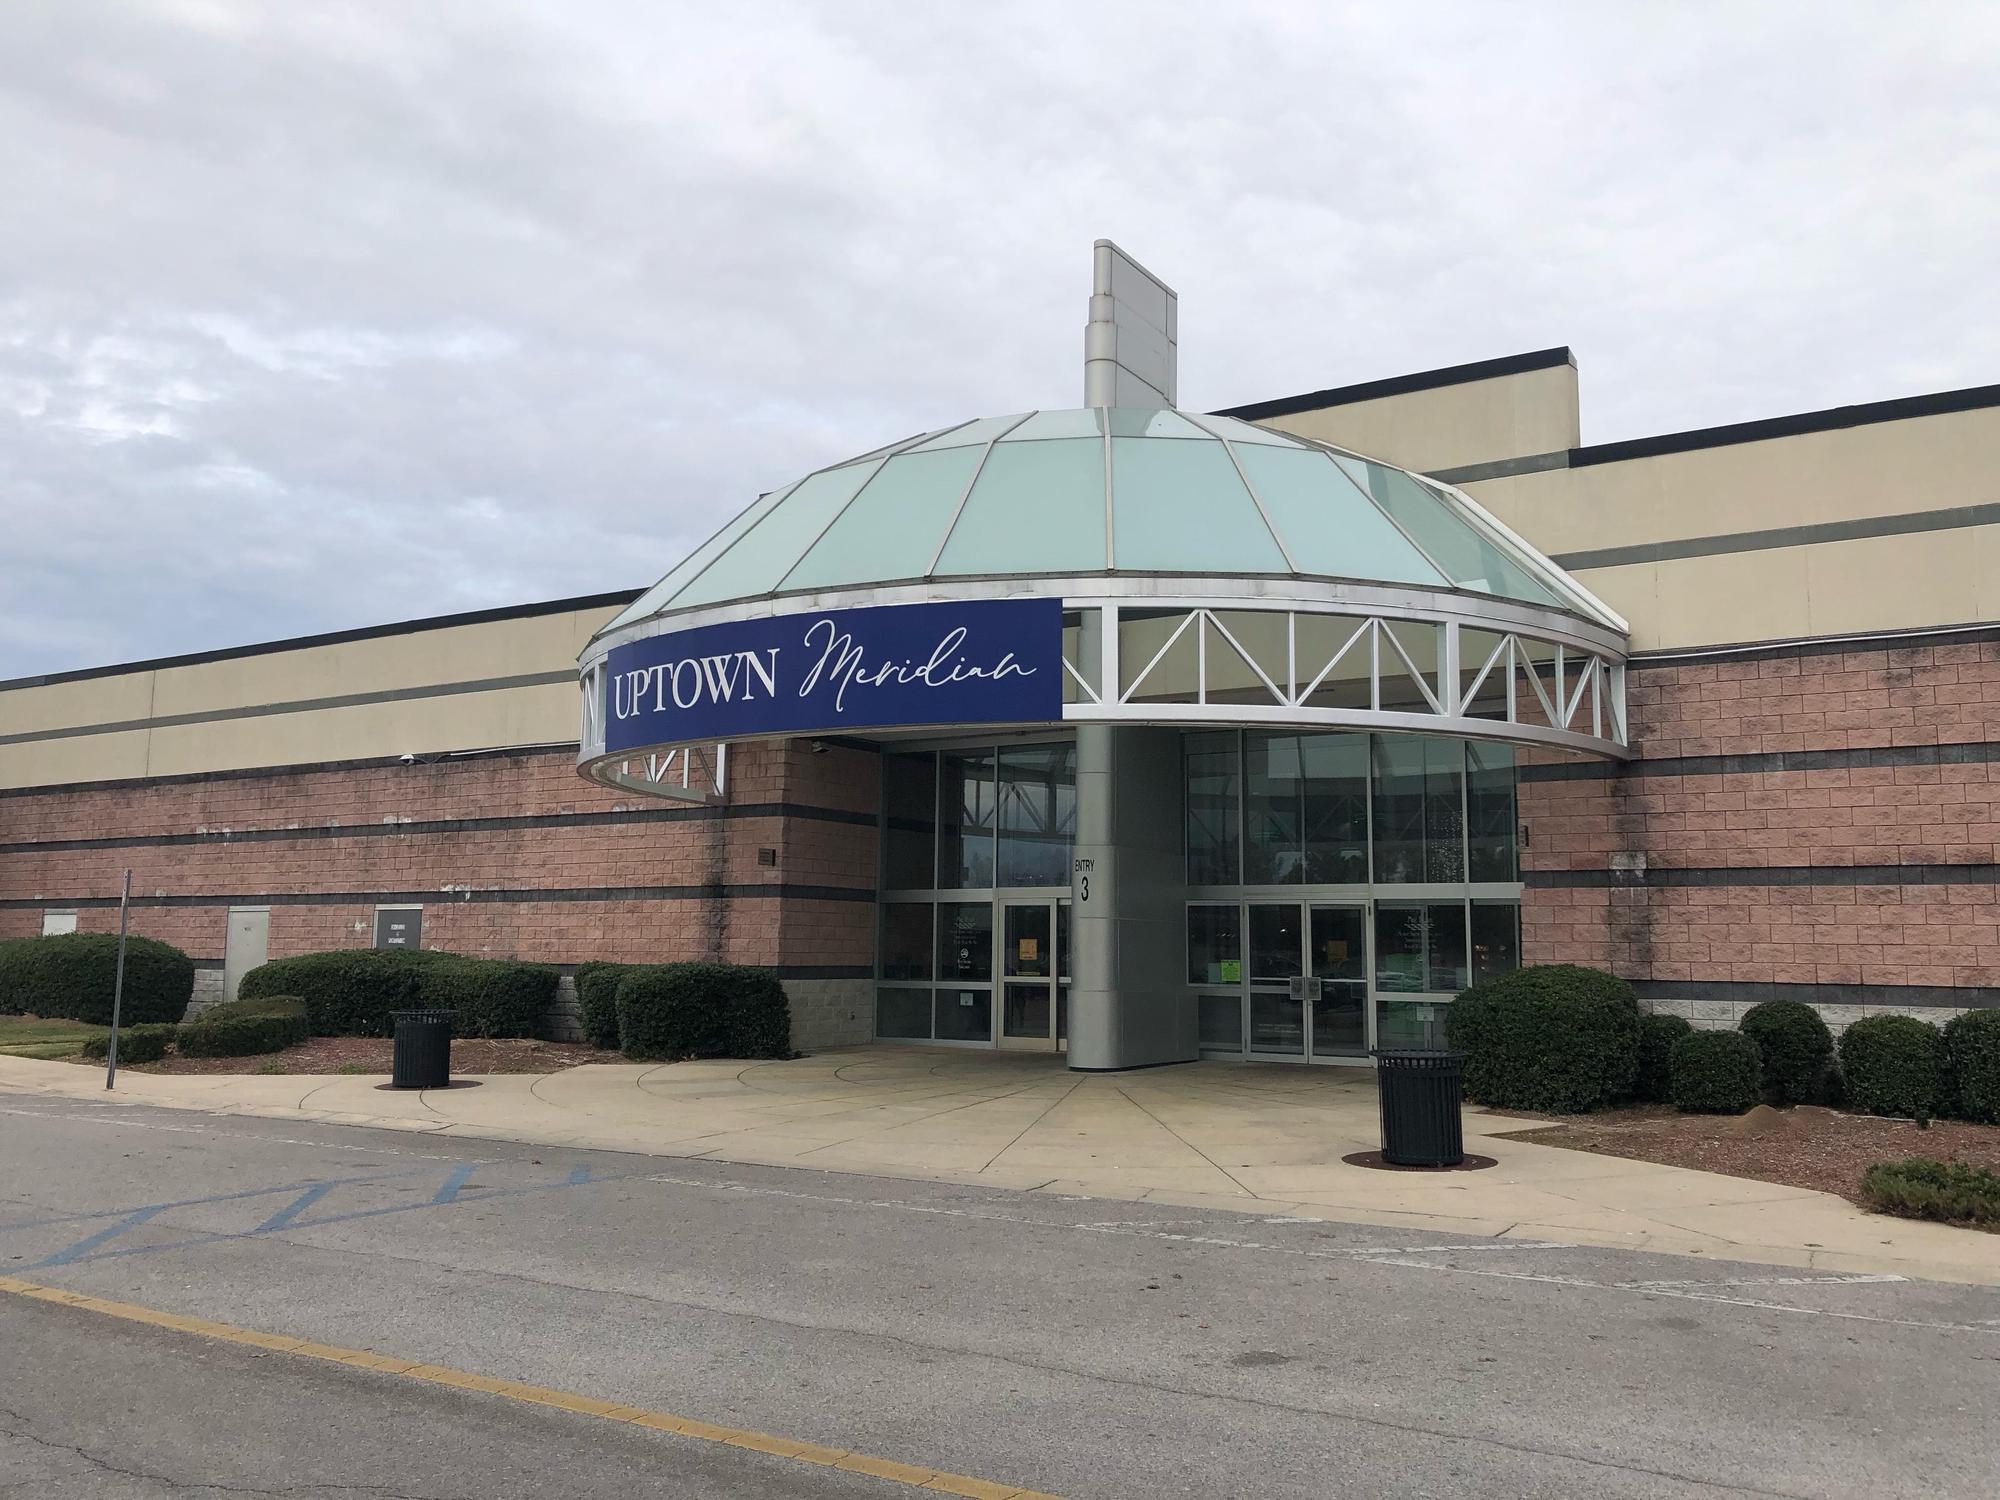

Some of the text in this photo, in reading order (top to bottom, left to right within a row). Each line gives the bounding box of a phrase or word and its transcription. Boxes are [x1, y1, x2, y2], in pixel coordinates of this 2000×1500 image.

[614, 619, 1037, 720] UPTOWN Meridian
[1075, 859, 1095, 872] ENTRY
[1081, 876, 1089, 901] 3
